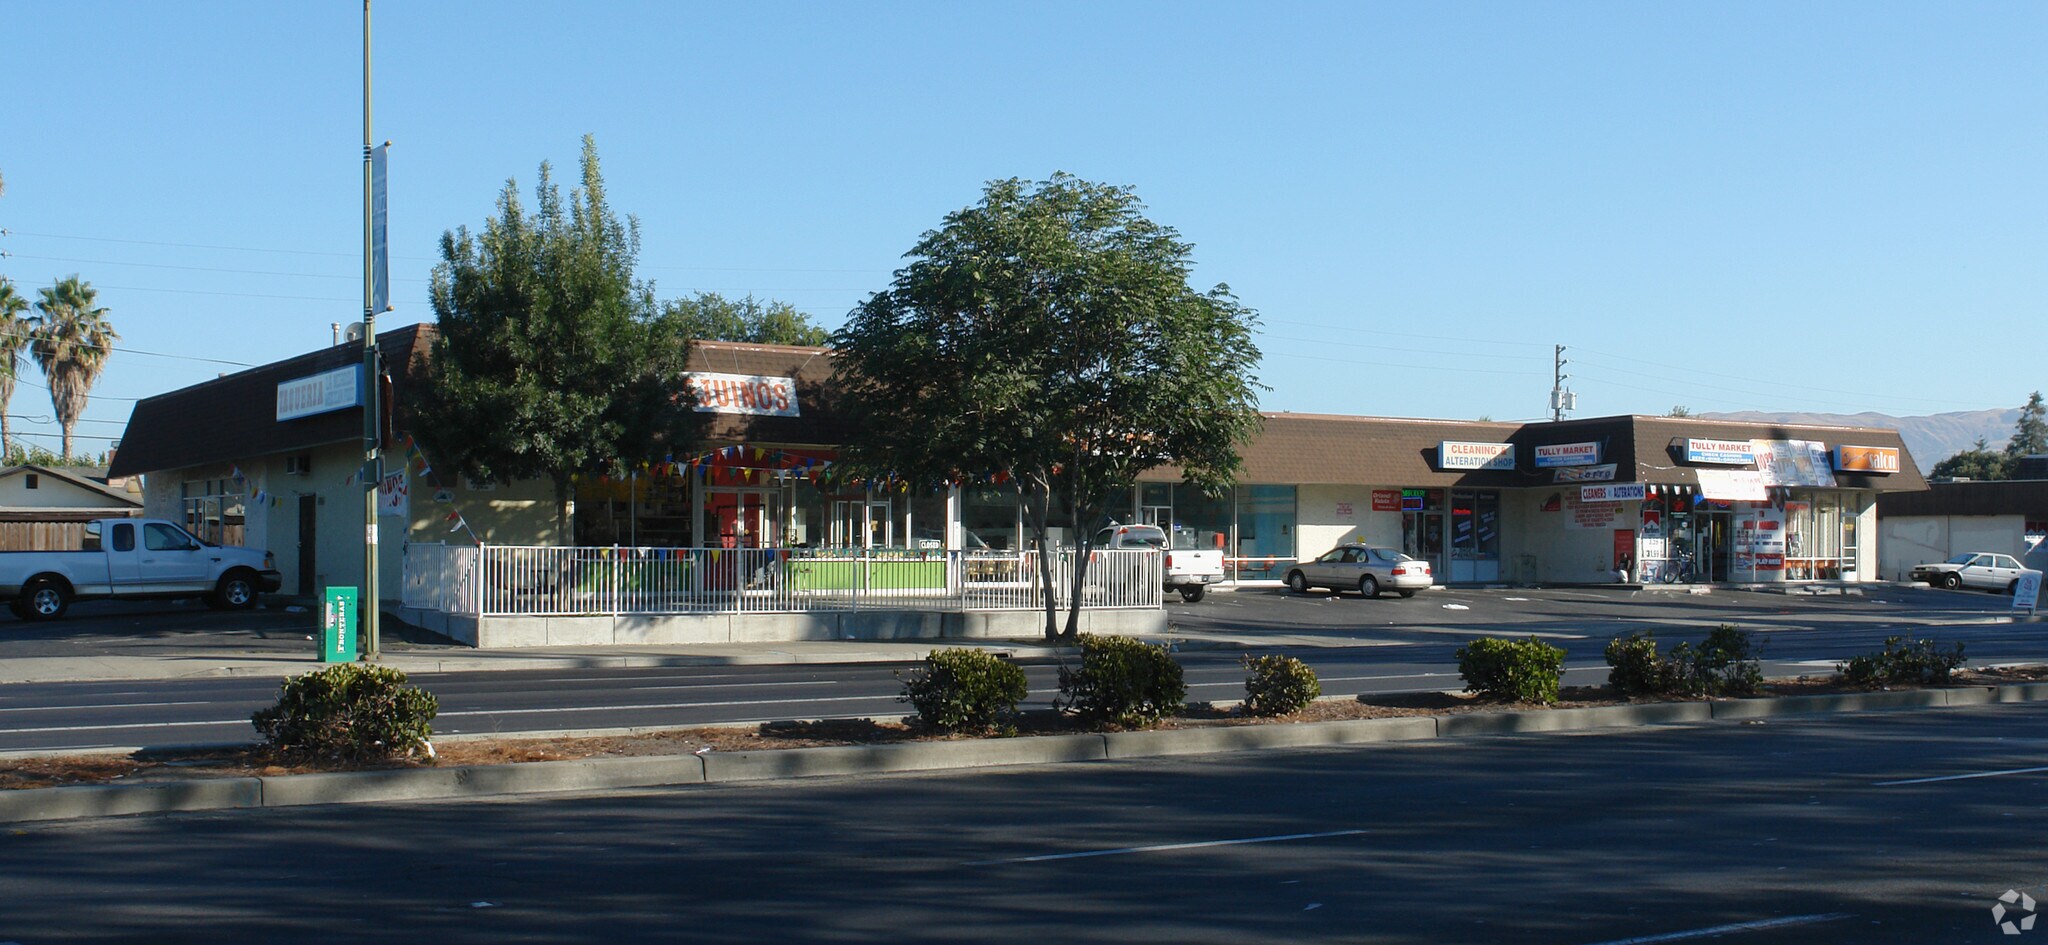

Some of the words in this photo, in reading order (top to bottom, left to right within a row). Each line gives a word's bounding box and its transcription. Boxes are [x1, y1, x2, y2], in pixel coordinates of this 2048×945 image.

[279, 380, 323, 414] TAQUERIA
[684, 378, 789, 410] JUINOS
[1451, 444, 1497, 455] CLEANING
[1538, 448, 1560, 456] TULLY
[1563, 445, 1594, 454] MARKET
[1691, 441, 1716, 450] TULLY
[1719, 443, 1751, 452] MARKET
[1446, 456, 1491, 466] ALTERATION
[1494, 457, 1513, 467] SHOP
[1579, 470, 1611, 479] LOTTO
[1583, 487, 1606, 499] CLEANERS
[1614, 485, 1644, 498] ALTERATIONS
[921, 541, 939, 549] CLOSED
